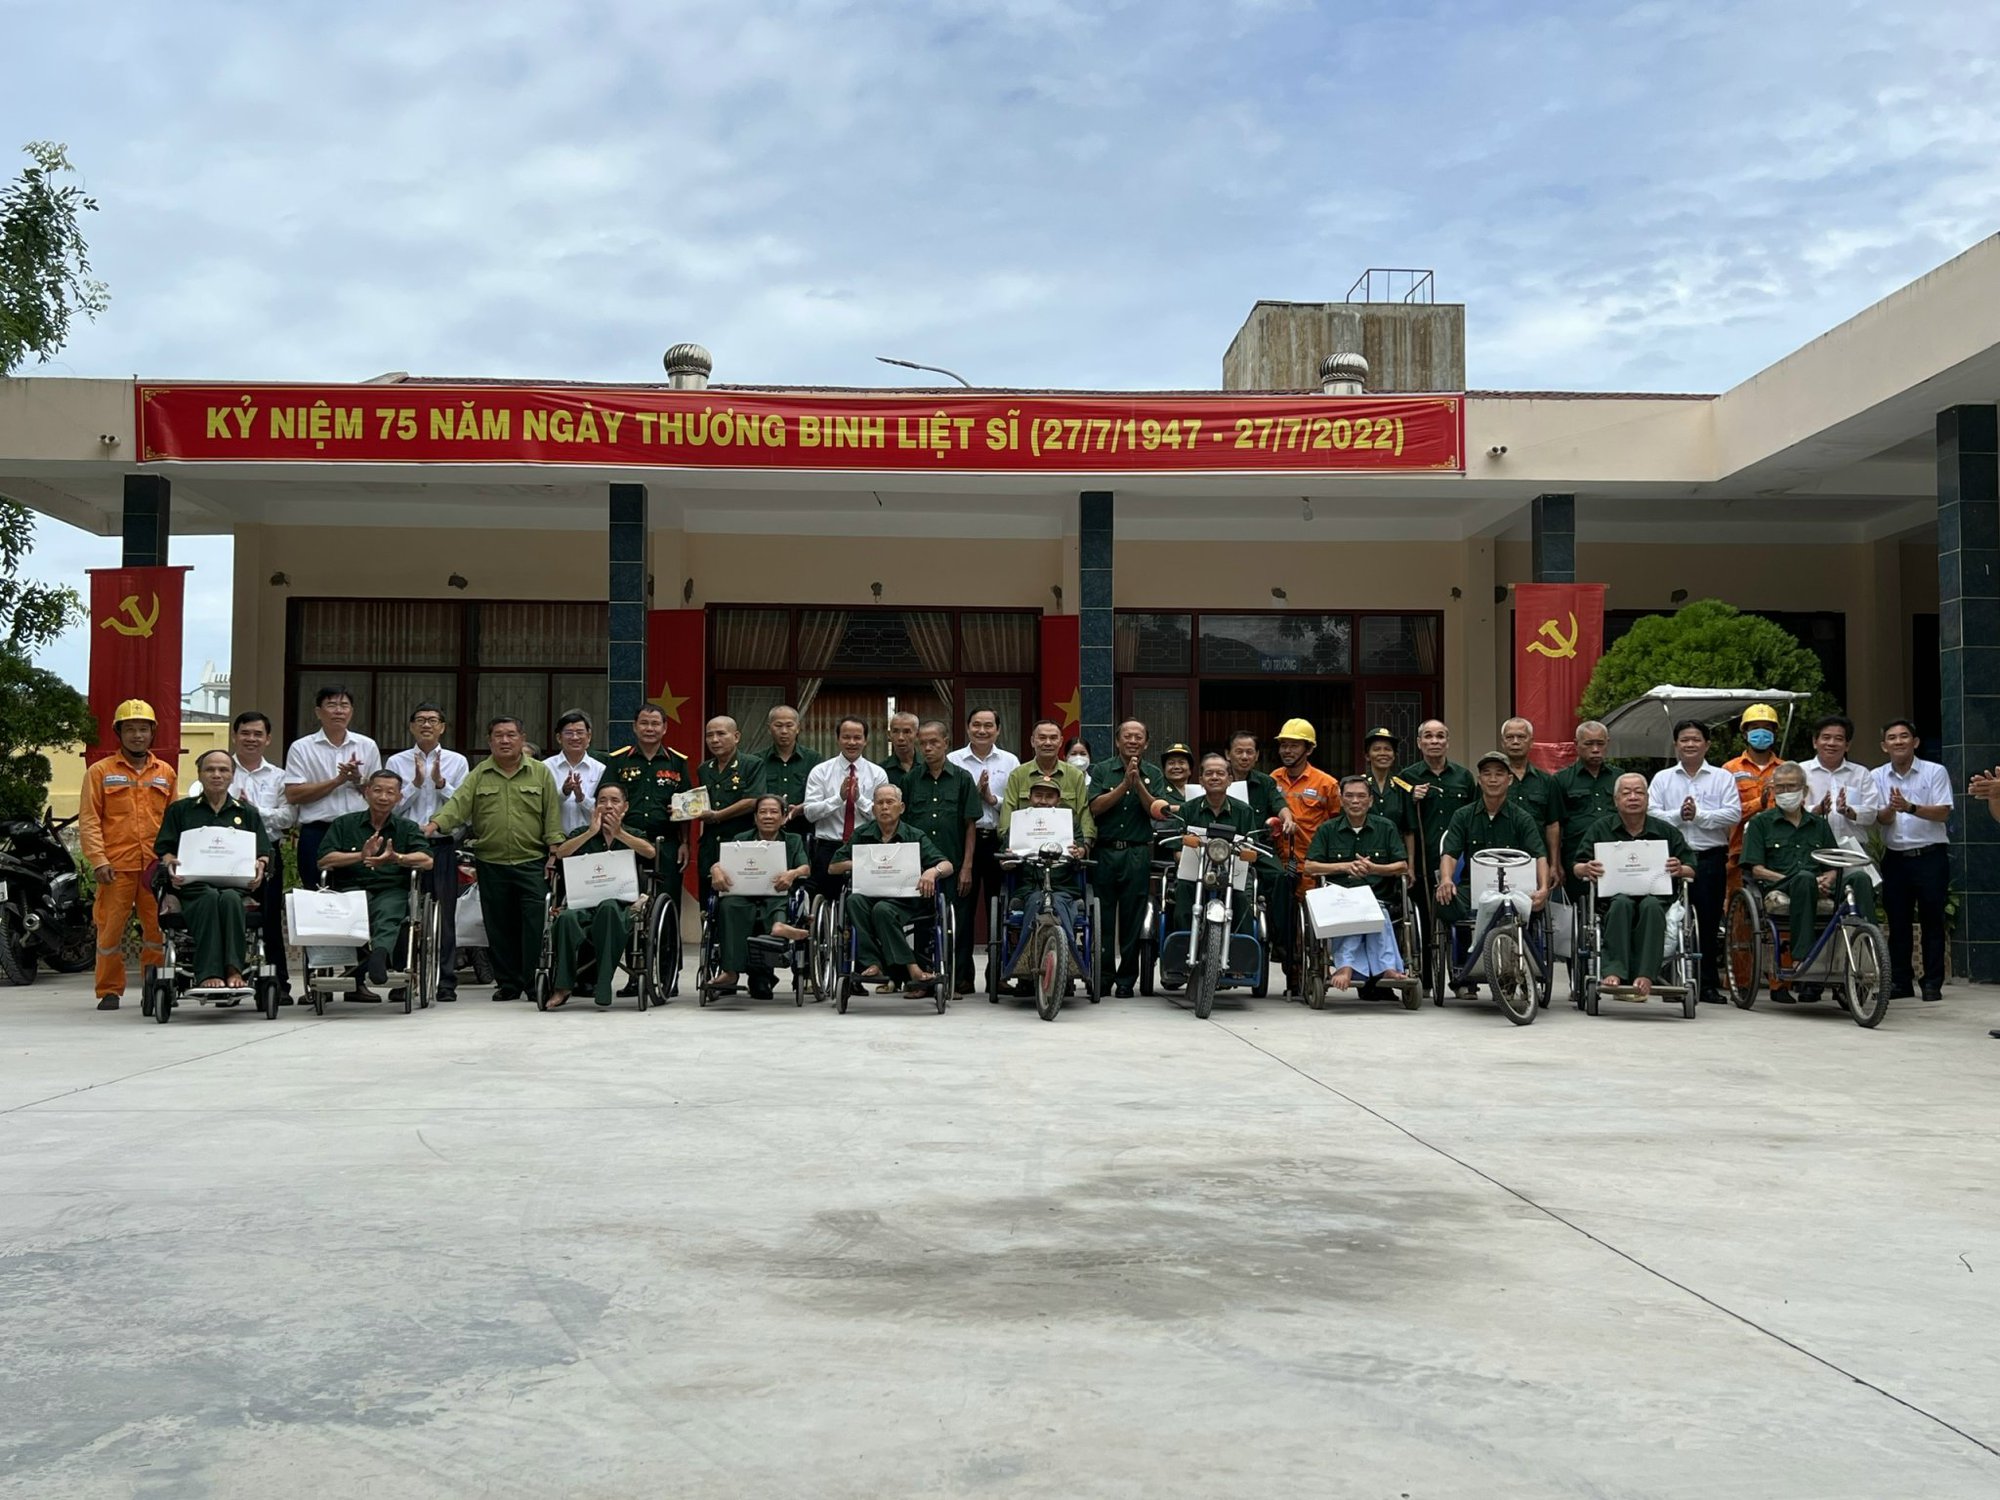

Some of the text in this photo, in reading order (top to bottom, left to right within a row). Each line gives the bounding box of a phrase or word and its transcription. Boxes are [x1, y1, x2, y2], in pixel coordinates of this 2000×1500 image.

[206, 395, 1404, 458] KỶ NIỆM 75 NĂM NGÀY THƯƠNG BINH LIỆT SĨ (27/7/1947 - 27/7/2022)
